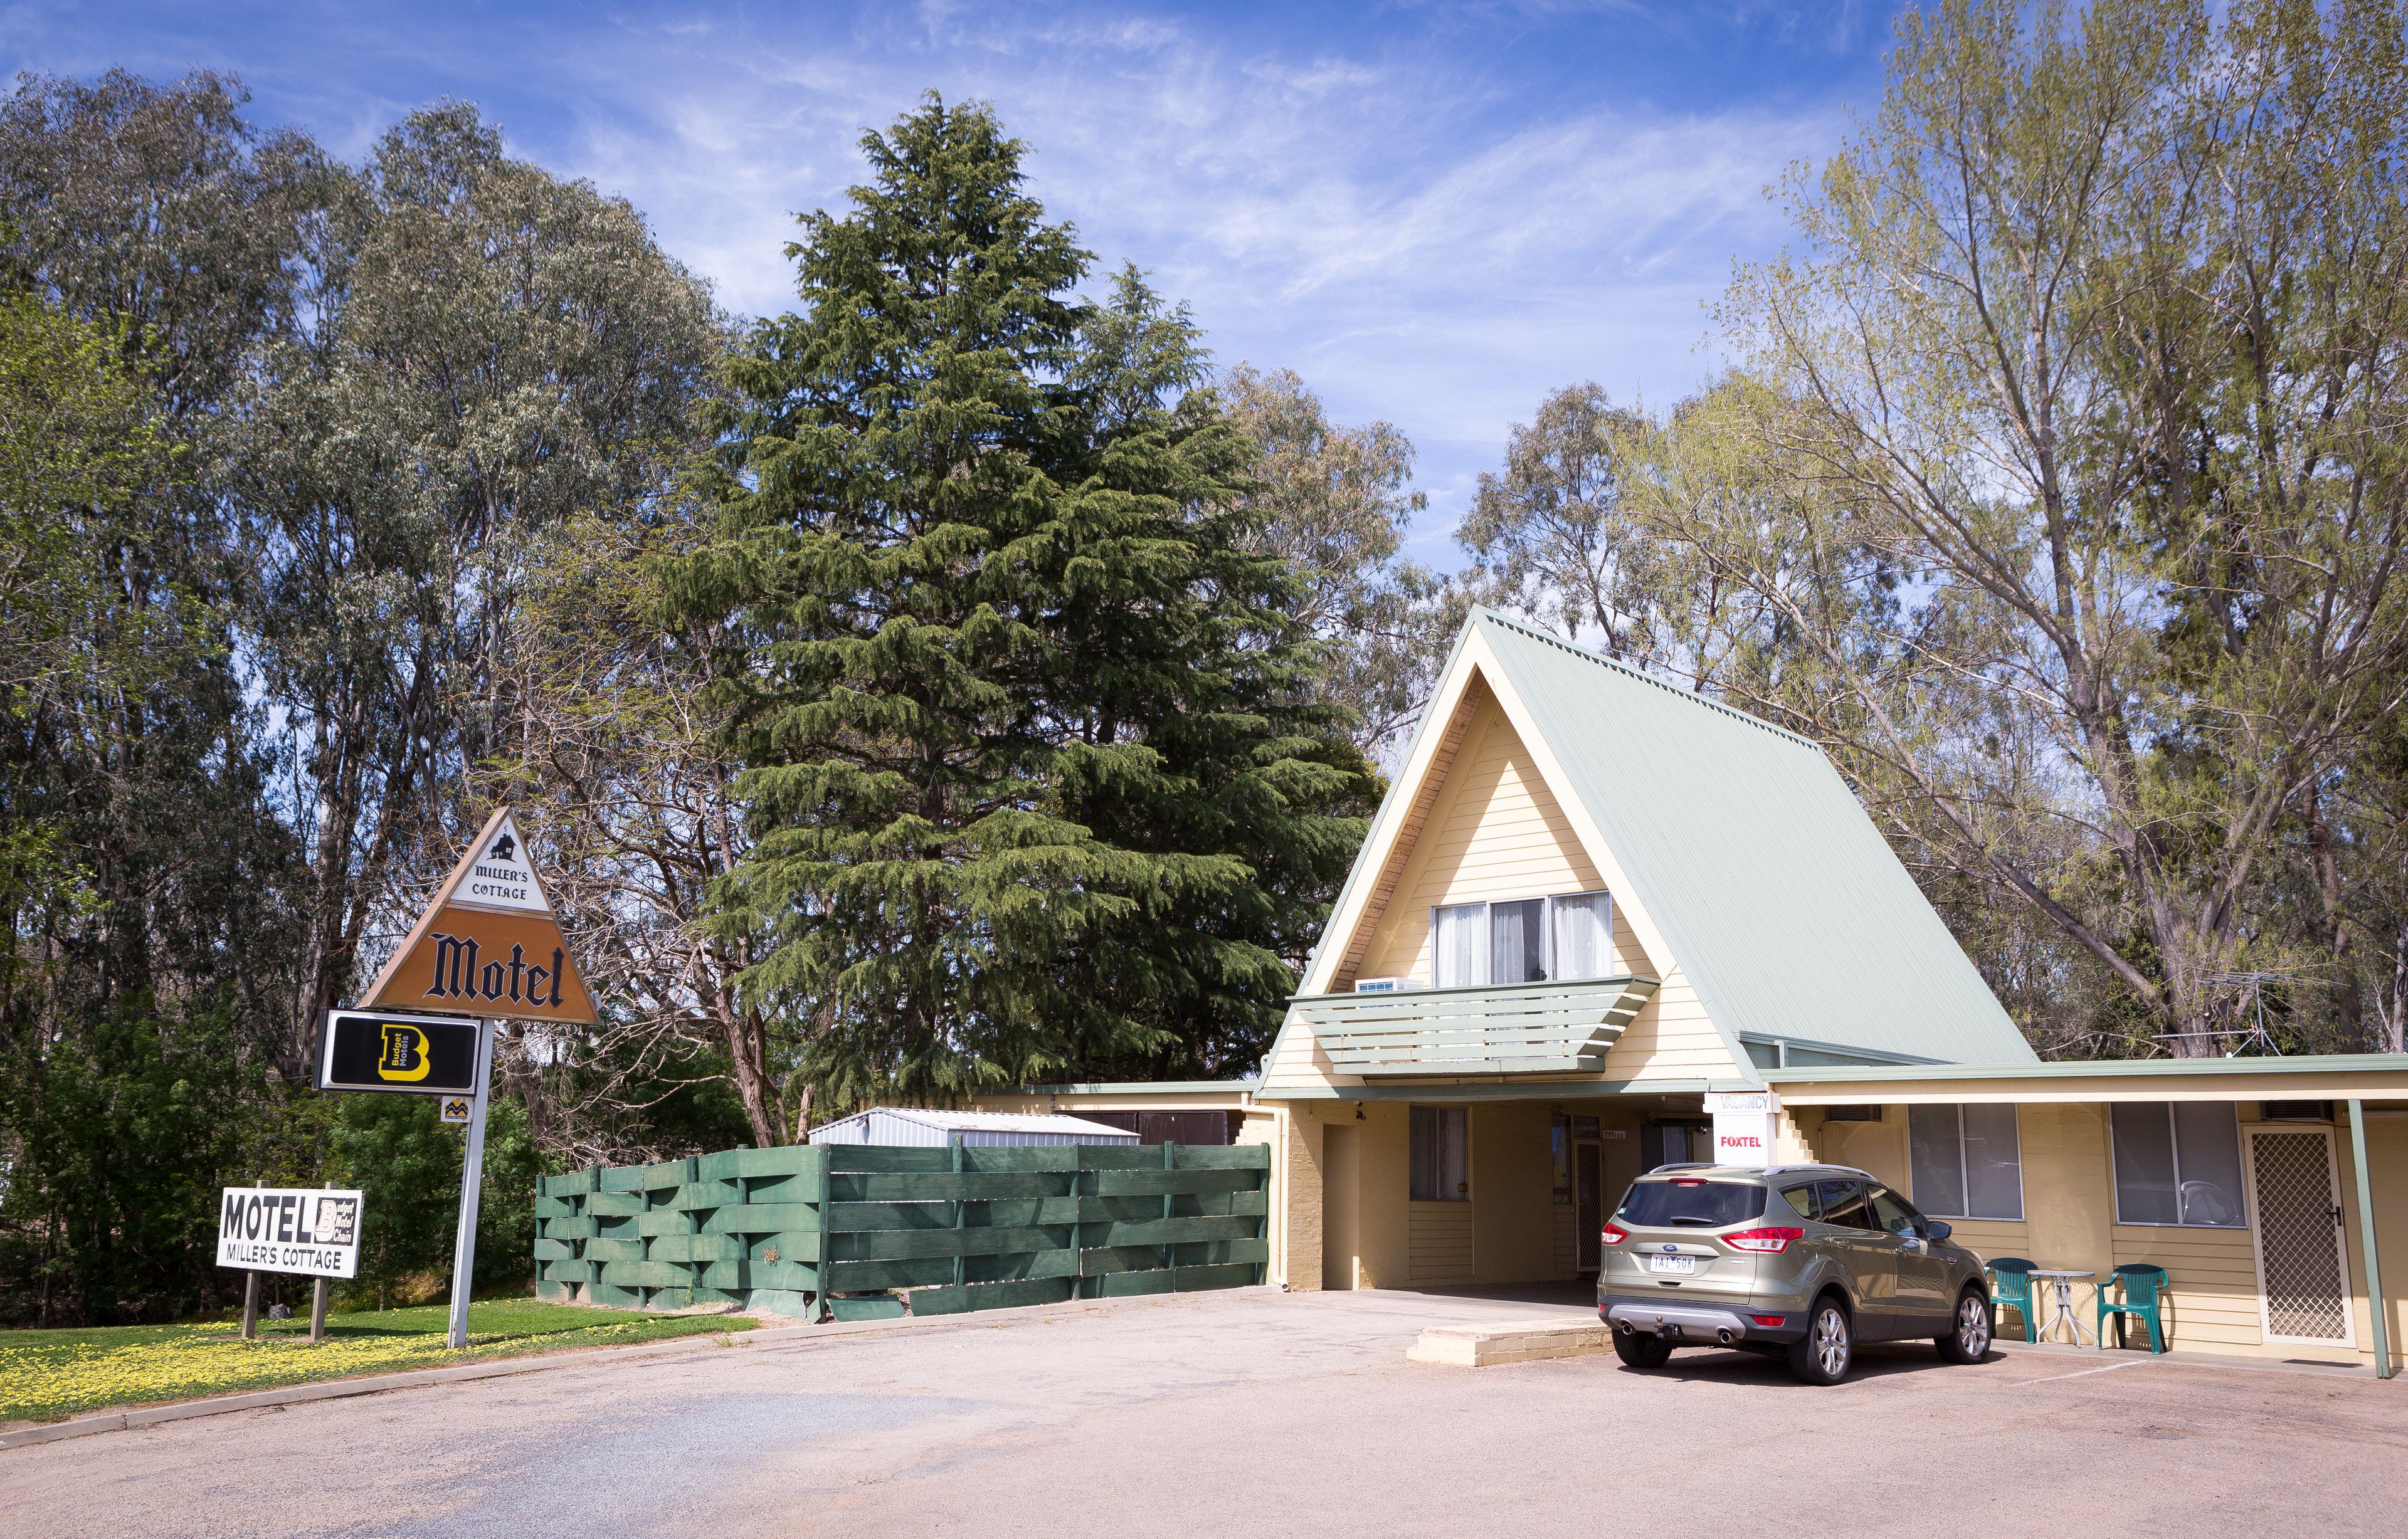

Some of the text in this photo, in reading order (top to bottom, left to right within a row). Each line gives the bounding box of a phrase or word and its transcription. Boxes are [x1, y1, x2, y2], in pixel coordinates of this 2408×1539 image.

[475, 865, 528, 883] MILLER'S
[472, 883, 527, 900] COTTAGE
[422, 932, 564, 1009] Motel
[391, 1033, 402, 1066] Budget
[399, 1036, 409, 1066] Motels
[1721, 1096, 1768, 1109] VACANCY
[1721, 1137, 1761, 1147] FOXTEL
[223, 1194, 312, 1244] MOTEL
[335, 1215, 354, 1229] Motel
[333, 1228, 352, 1242] Chain
[226, 1244, 342, 1270] MILLER'S COTTAGE
